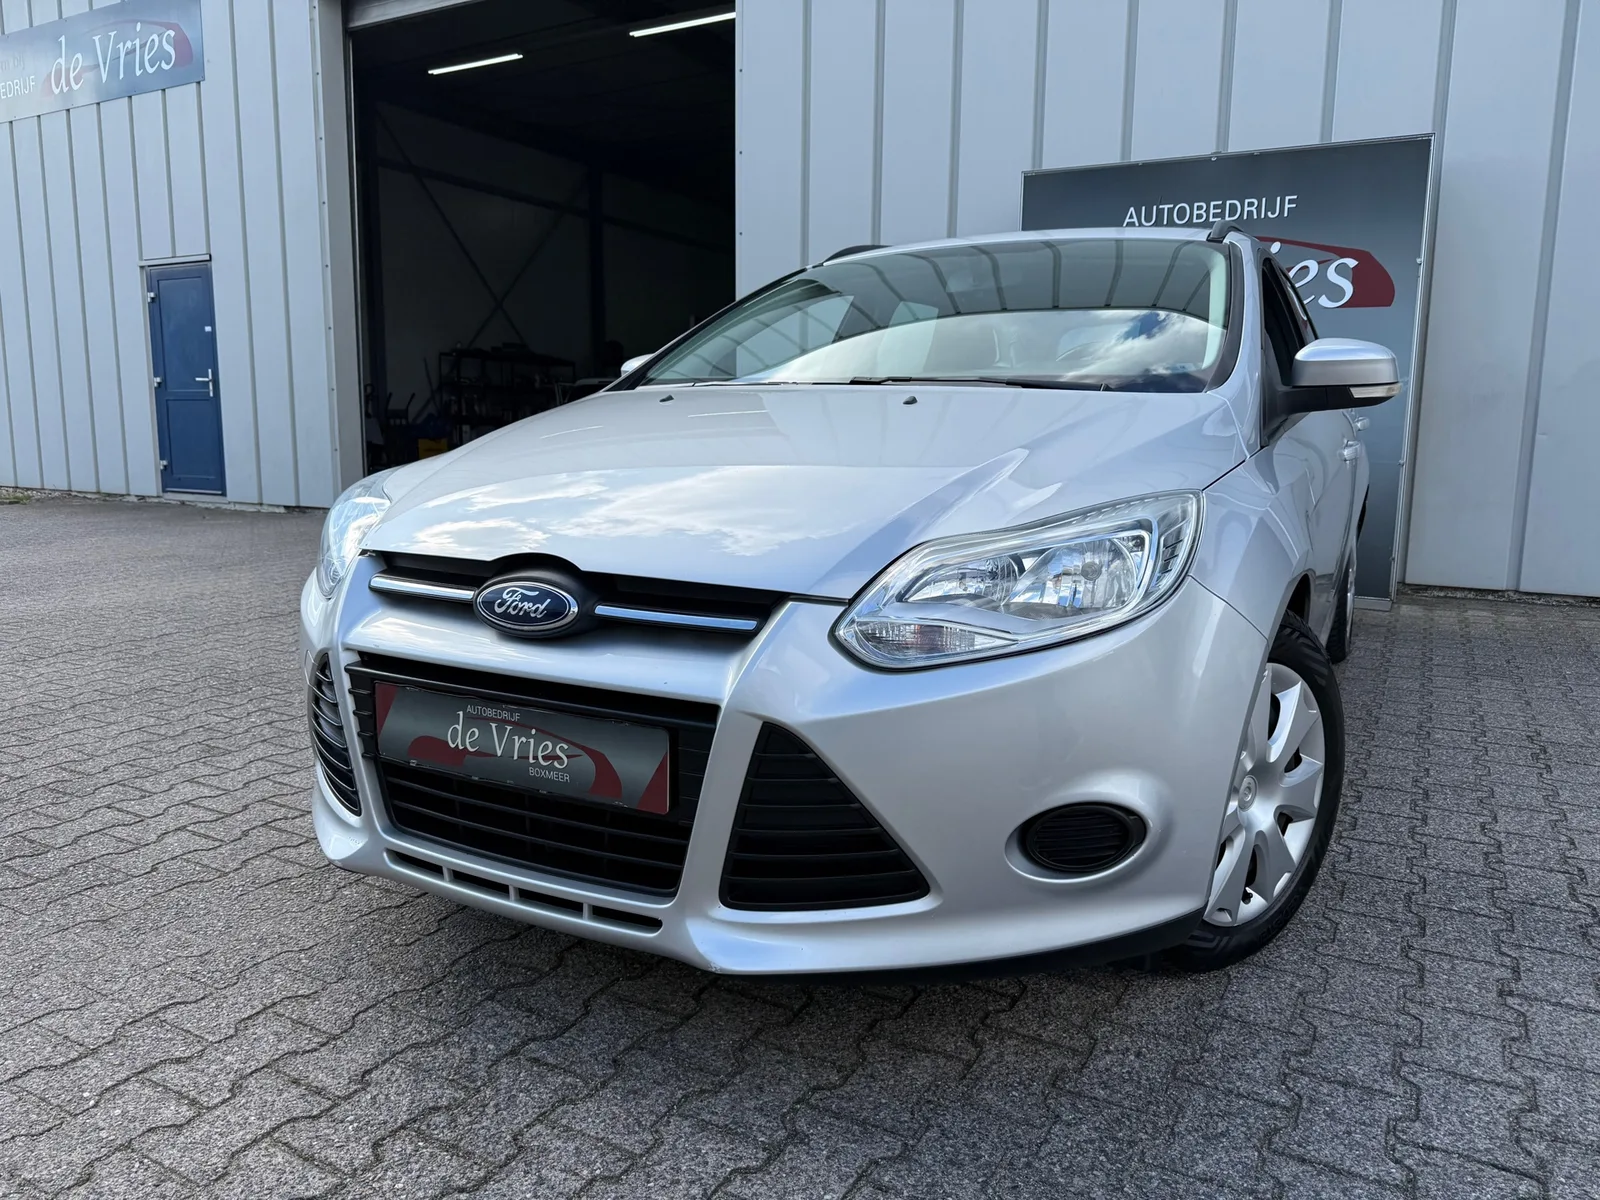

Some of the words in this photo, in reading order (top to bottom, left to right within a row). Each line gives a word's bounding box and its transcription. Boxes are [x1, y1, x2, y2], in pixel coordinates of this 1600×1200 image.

[51, 35, 84, 95] de
[92, 22, 176, 84] Vries
[1123, 195, 1298, 228] AUTOBEDRIJF
[494, 587, 551, 618] Ford
[466, 704, 521, 722] AUTOBEDRIJF
[447, 711, 480, 752] de
[489, 722, 569, 769] Vries
[528, 766, 570, 783] BOXMEER
